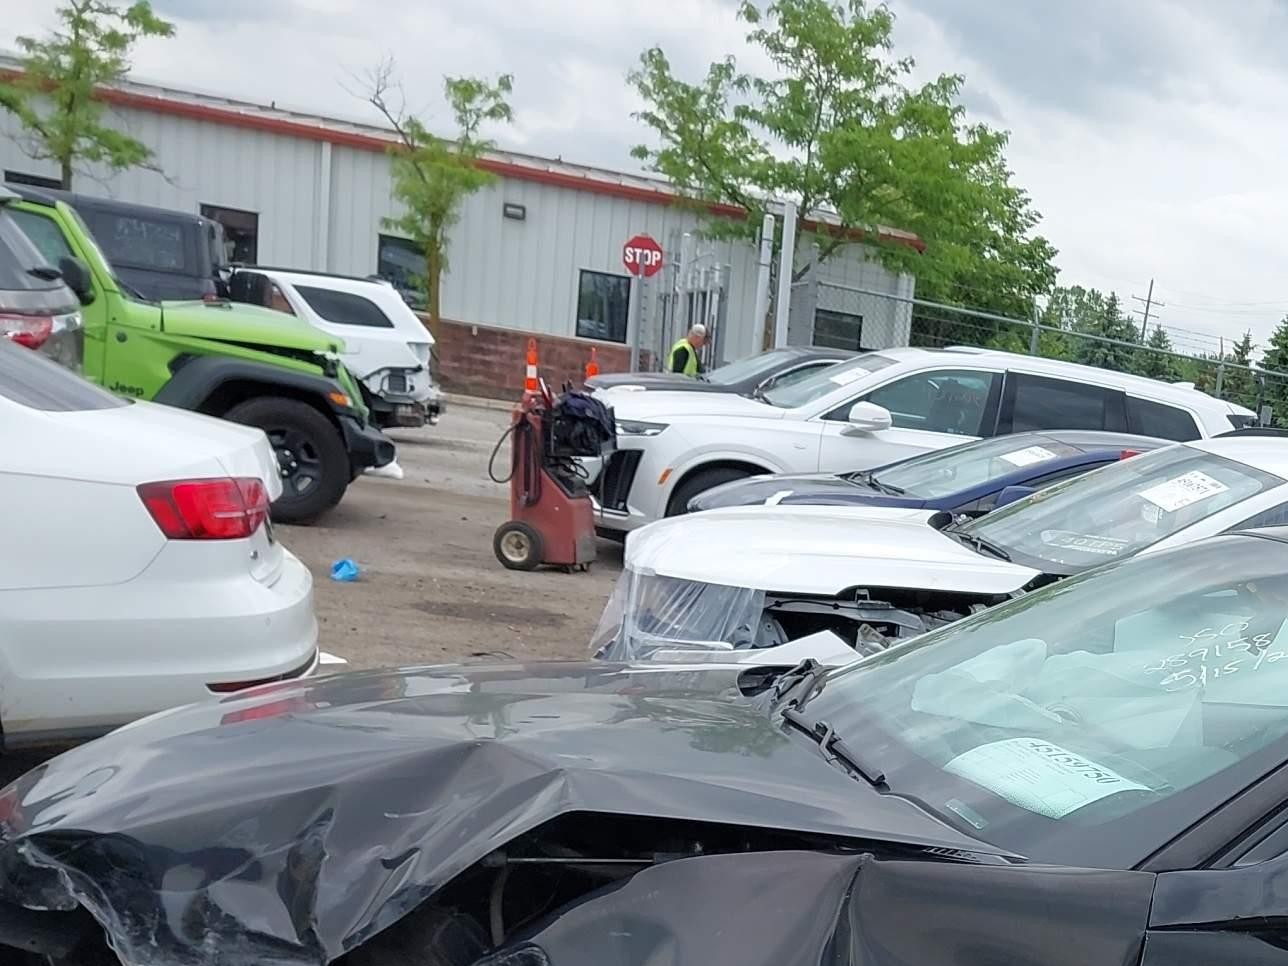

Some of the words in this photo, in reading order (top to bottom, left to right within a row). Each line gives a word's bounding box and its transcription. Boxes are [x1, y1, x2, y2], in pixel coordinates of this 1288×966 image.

[625, 246, 661, 267] STOP
[109, 381, 144, 398] Jeep
[1029, 742, 1121, 784] 45159750
